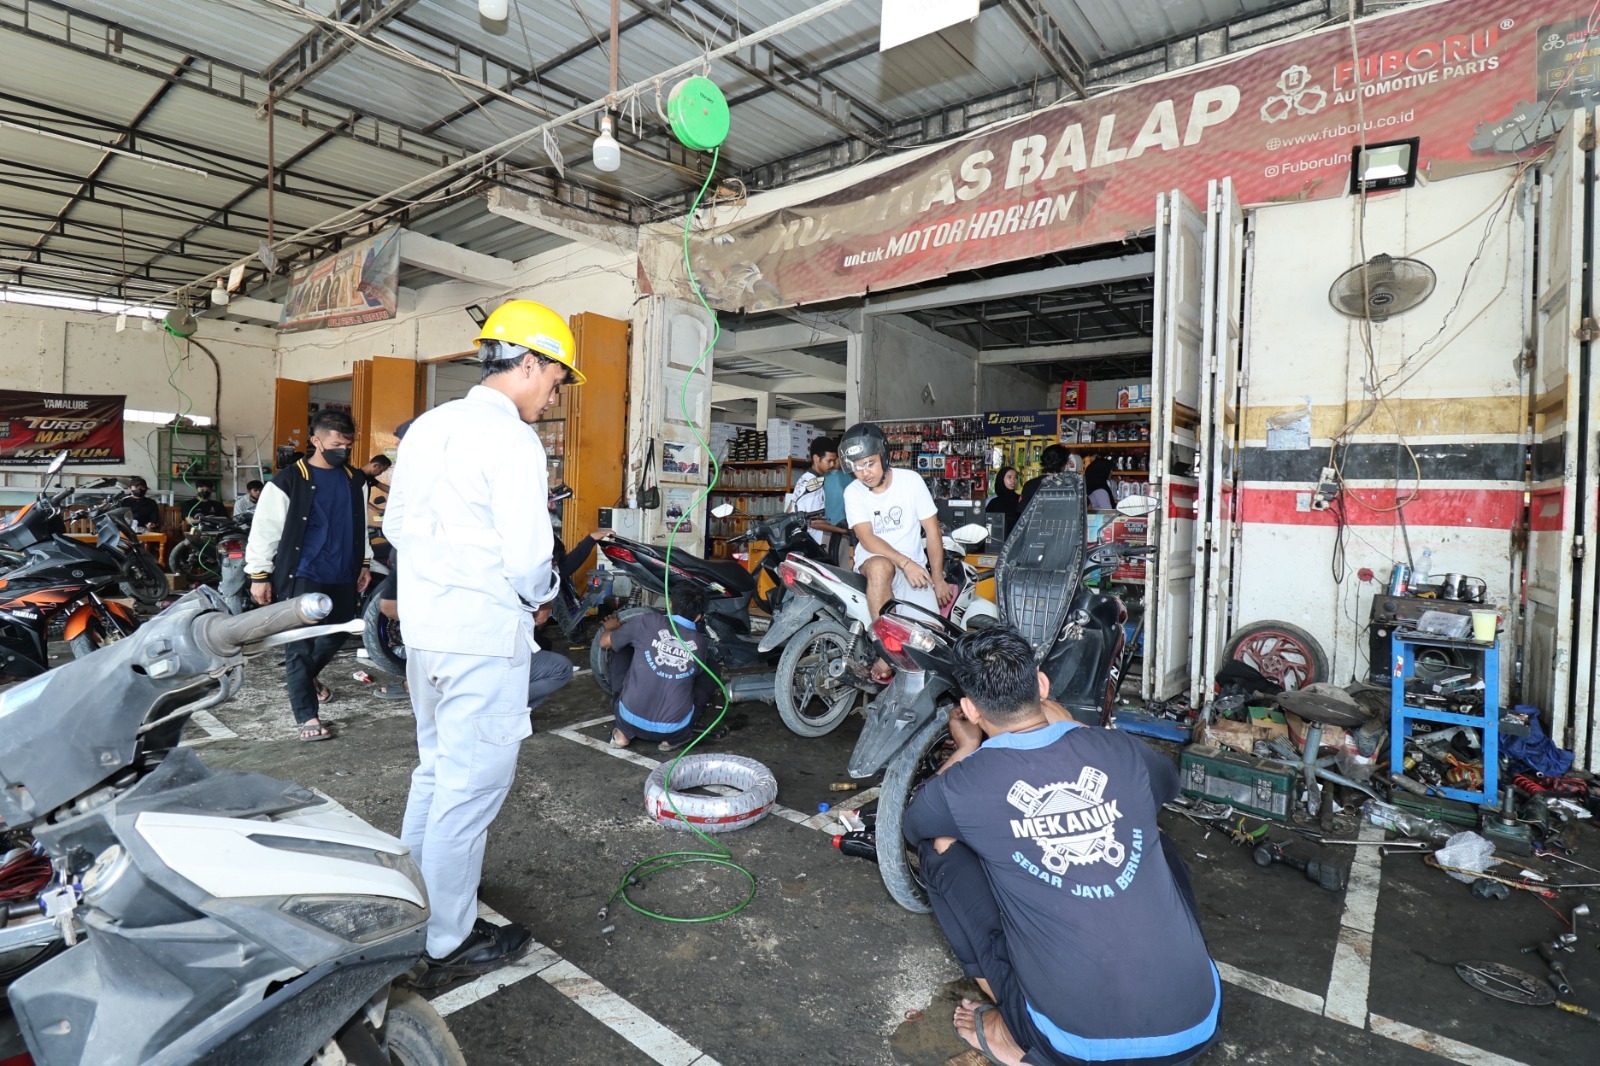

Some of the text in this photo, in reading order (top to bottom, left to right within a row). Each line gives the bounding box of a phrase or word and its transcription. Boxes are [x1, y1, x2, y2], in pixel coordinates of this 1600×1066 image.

[1333, 26, 1499, 91] FUBORU
[1334, 56, 1499, 104] AUTOMOTIVE PARTS
[1005, 84, 1241, 190] BALAP
[1283, 109, 1414, 147] www.fuboru.co.id
[843, 192, 1076, 268] untuk MOTOR HARIAN
[43, 399, 89, 410] YAMALUBE
[12, 610, 38, 620] YAMAHA
[1010, 799, 1123, 838] MEKANIK
[1011, 828, 1143, 900] SEGAR JAYA BERKAH
